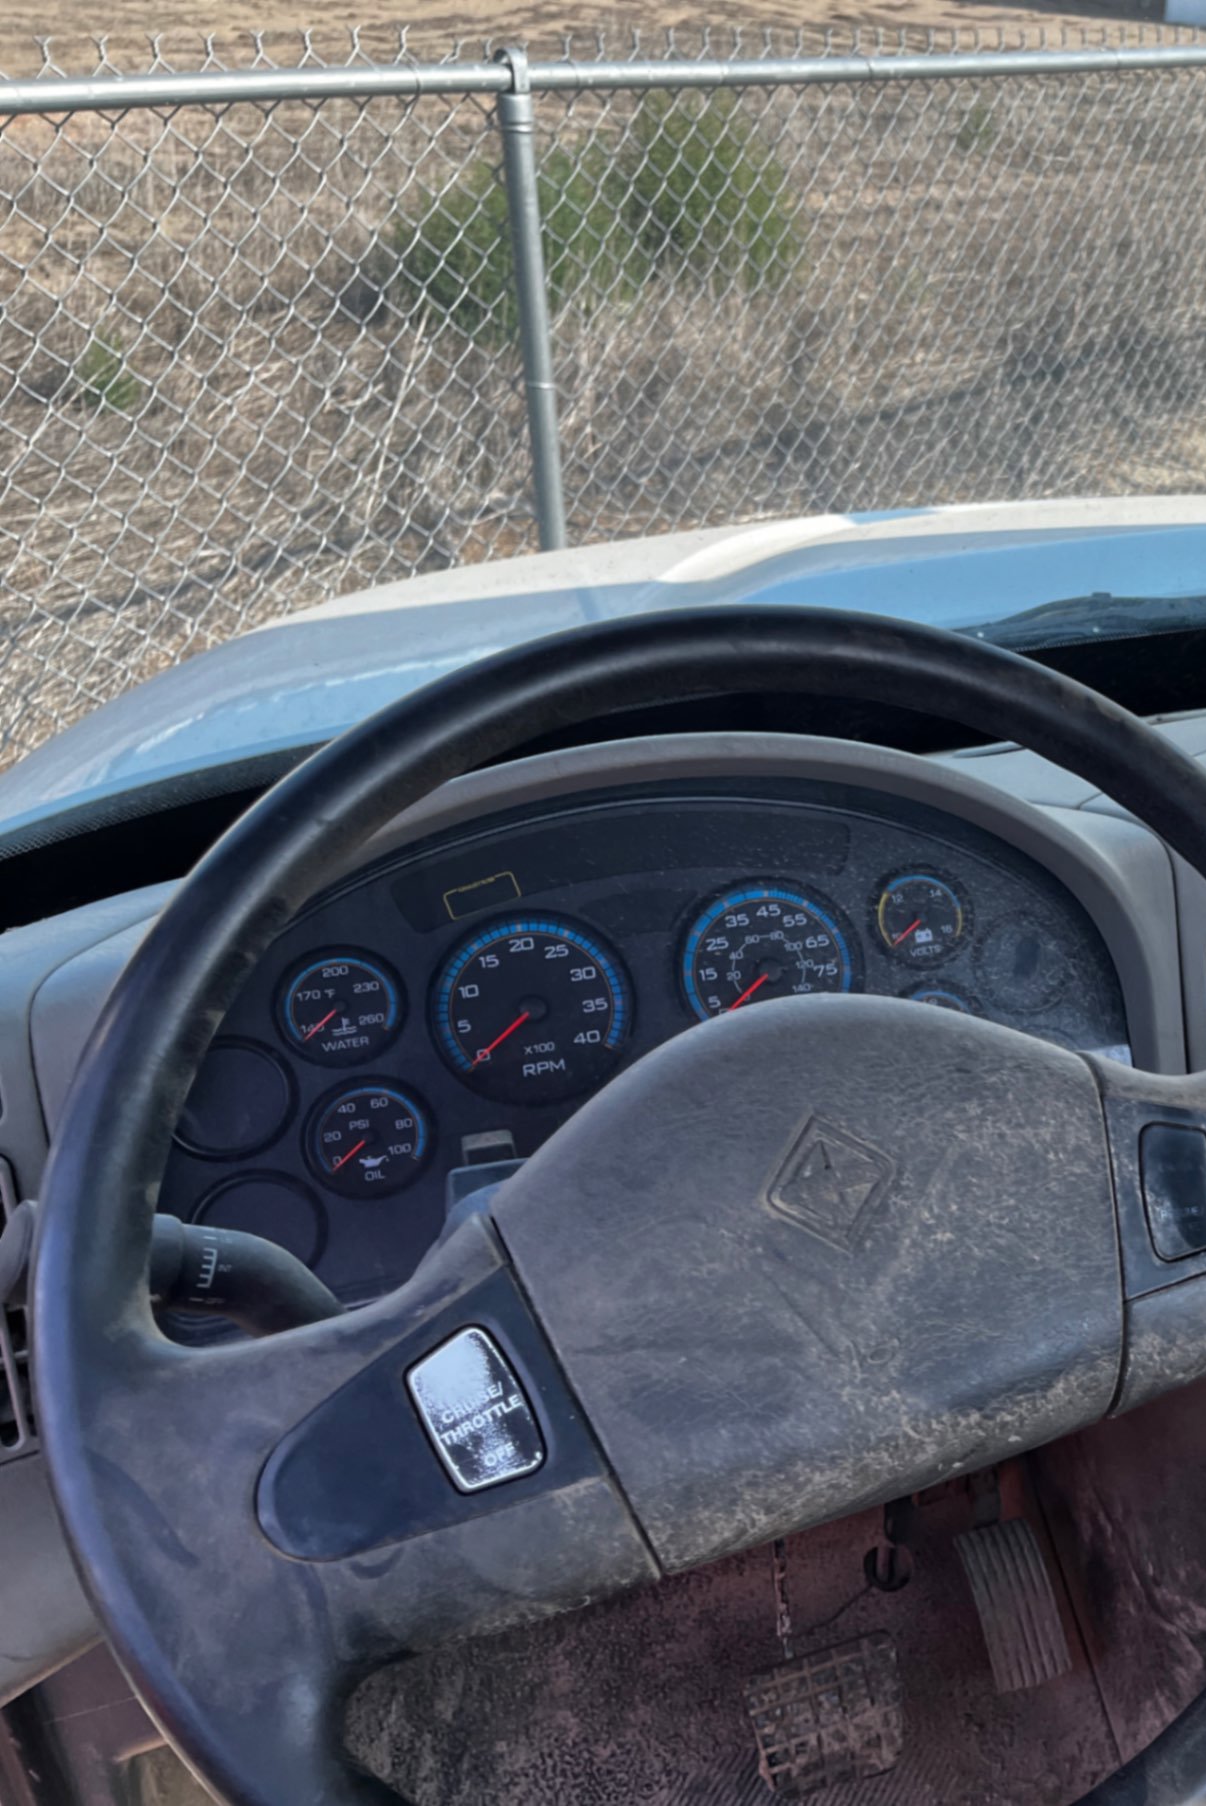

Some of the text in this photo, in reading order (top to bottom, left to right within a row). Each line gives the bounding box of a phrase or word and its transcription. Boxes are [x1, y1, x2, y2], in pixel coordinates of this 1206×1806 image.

[756, 904, 781, 918] 45
[725, 914, 750, 928] 35
[783, 913, 807, 928] 55
[508, 937, 534, 952] 20
[706, 936, 729, 952] 25
[806, 934, 830, 948] 65
[544, 944, 569, 959] 25
[479, 954, 500, 968] 15
[322, 966, 349, 978] 200
[570, 966, 596, 982] 30
[699, 968, 718, 981] 15
[813, 963, 838, 978] 75
[353, 982, 380, 994] 230
[458, 984, 479, 998] 10
[297, 990, 320, 1002] 170
[708, 996, 720, 1008] 5
[582, 998, 608, 1013] 35
[358, 1013, 384, 1026] 260
[458, 1020, 471, 1033] 5
[321, 1036, 369, 1052] WATER
[574, 1030, 600, 1044] 40
[476, 1049, 490, 1062] 0
[522, 1058, 566, 1077] RPM
[337, 1103, 356, 1114] 40
[370, 1097, 388, 1108] 60
[348, 1120, 370, 1130] PSI
[395, 1118, 412, 1130] 80
[324, 1130, 341, 1142] 20
[388, 1144, 412, 1155] 100
[364, 1170, 385, 1182] OIL
[440, 1394, 521, 1446] THROTTLE
[484, 1442, 516, 1467] OFF
